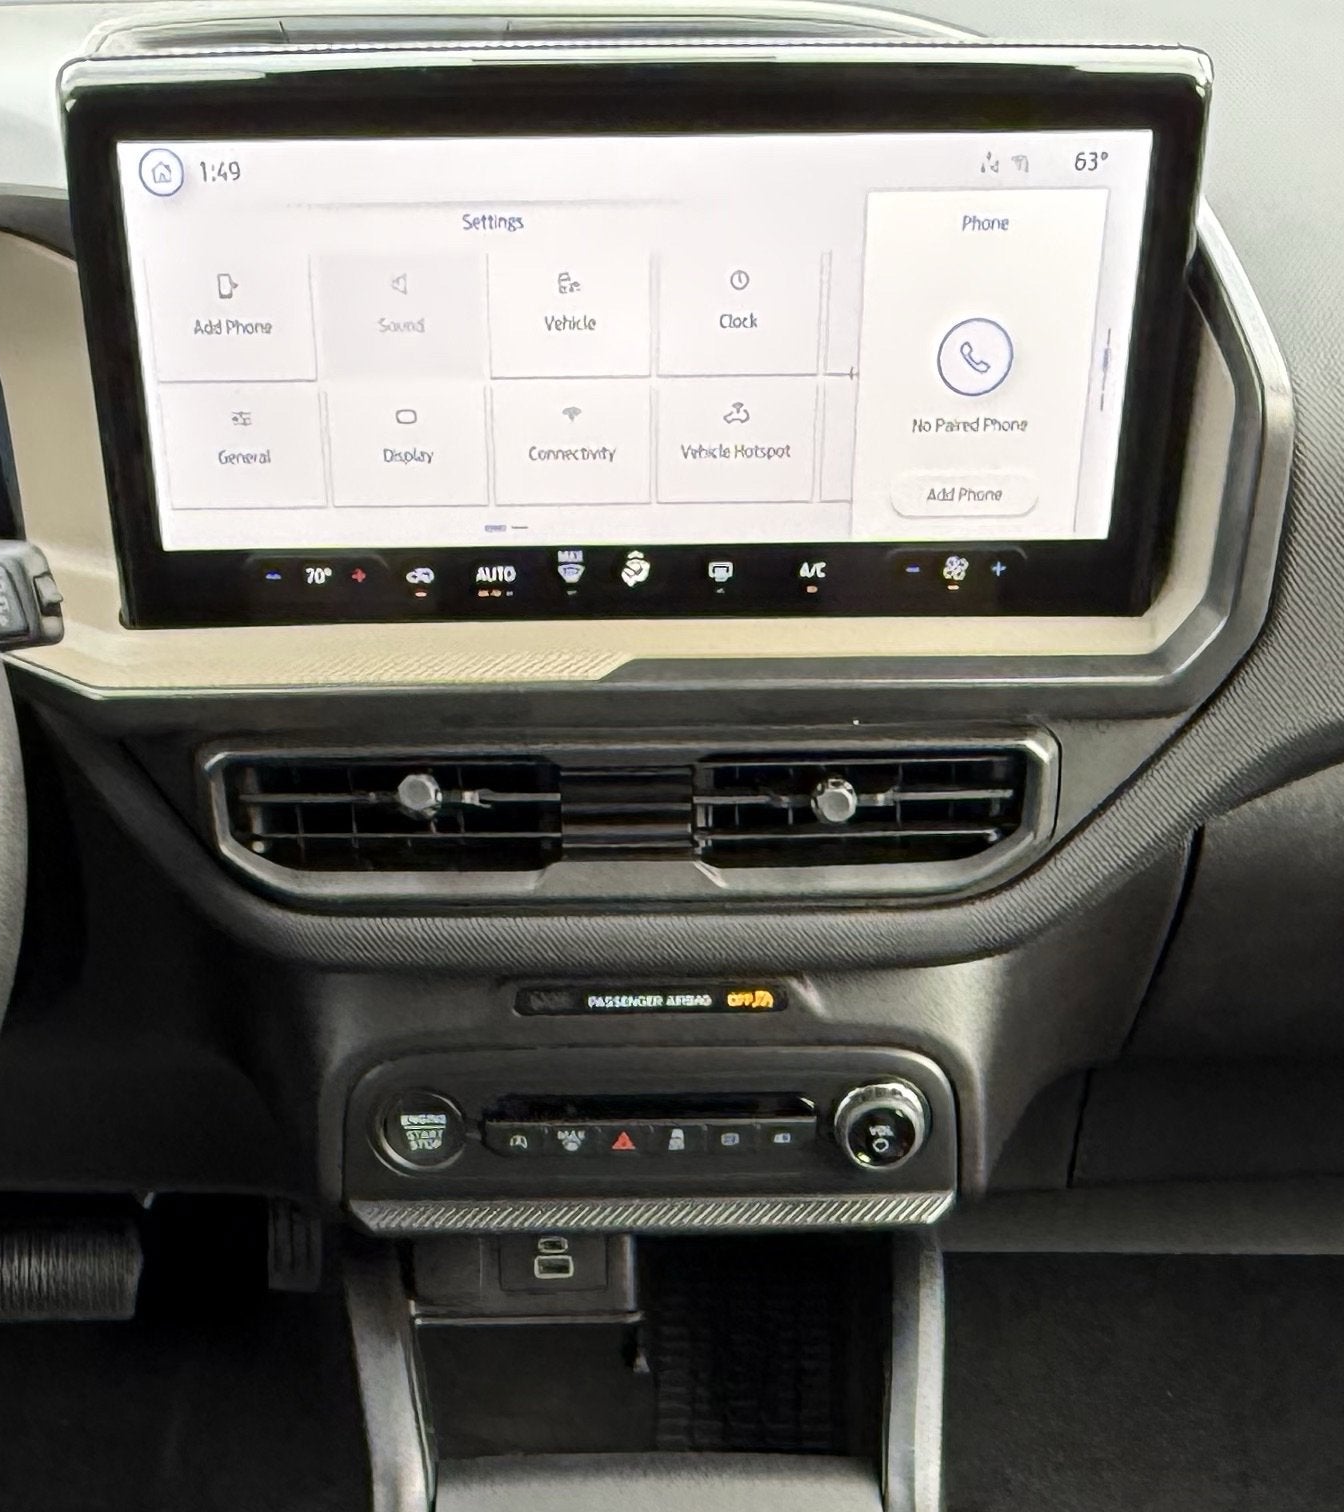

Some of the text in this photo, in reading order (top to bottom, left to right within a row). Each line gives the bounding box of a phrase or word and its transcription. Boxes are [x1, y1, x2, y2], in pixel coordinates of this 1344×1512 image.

[199, 161, 241, 182] 1:49
[461, 213, 525, 232] Settings
[961, 214, 1010, 232] Phone
[193, 318, 273, 335] Add Phone
[544, 315, 597, 332] Vehicle
[719, 312, 758, 330] Clock
[912, 418, 932, 432] No
[982, 417, 1028, 433] Phone
[217, 449, 272, 465] General
[382, 448, 435, 466] Display
[528, 446, 617, 465] Connectivity
[680, 444, 792, 462] Vehicle Hotspot
[926, 487, 1003, 503] Add Phone
[475, 566, 517, 583] AUTO
[587, 994, 664, 1009] PASSENGER
